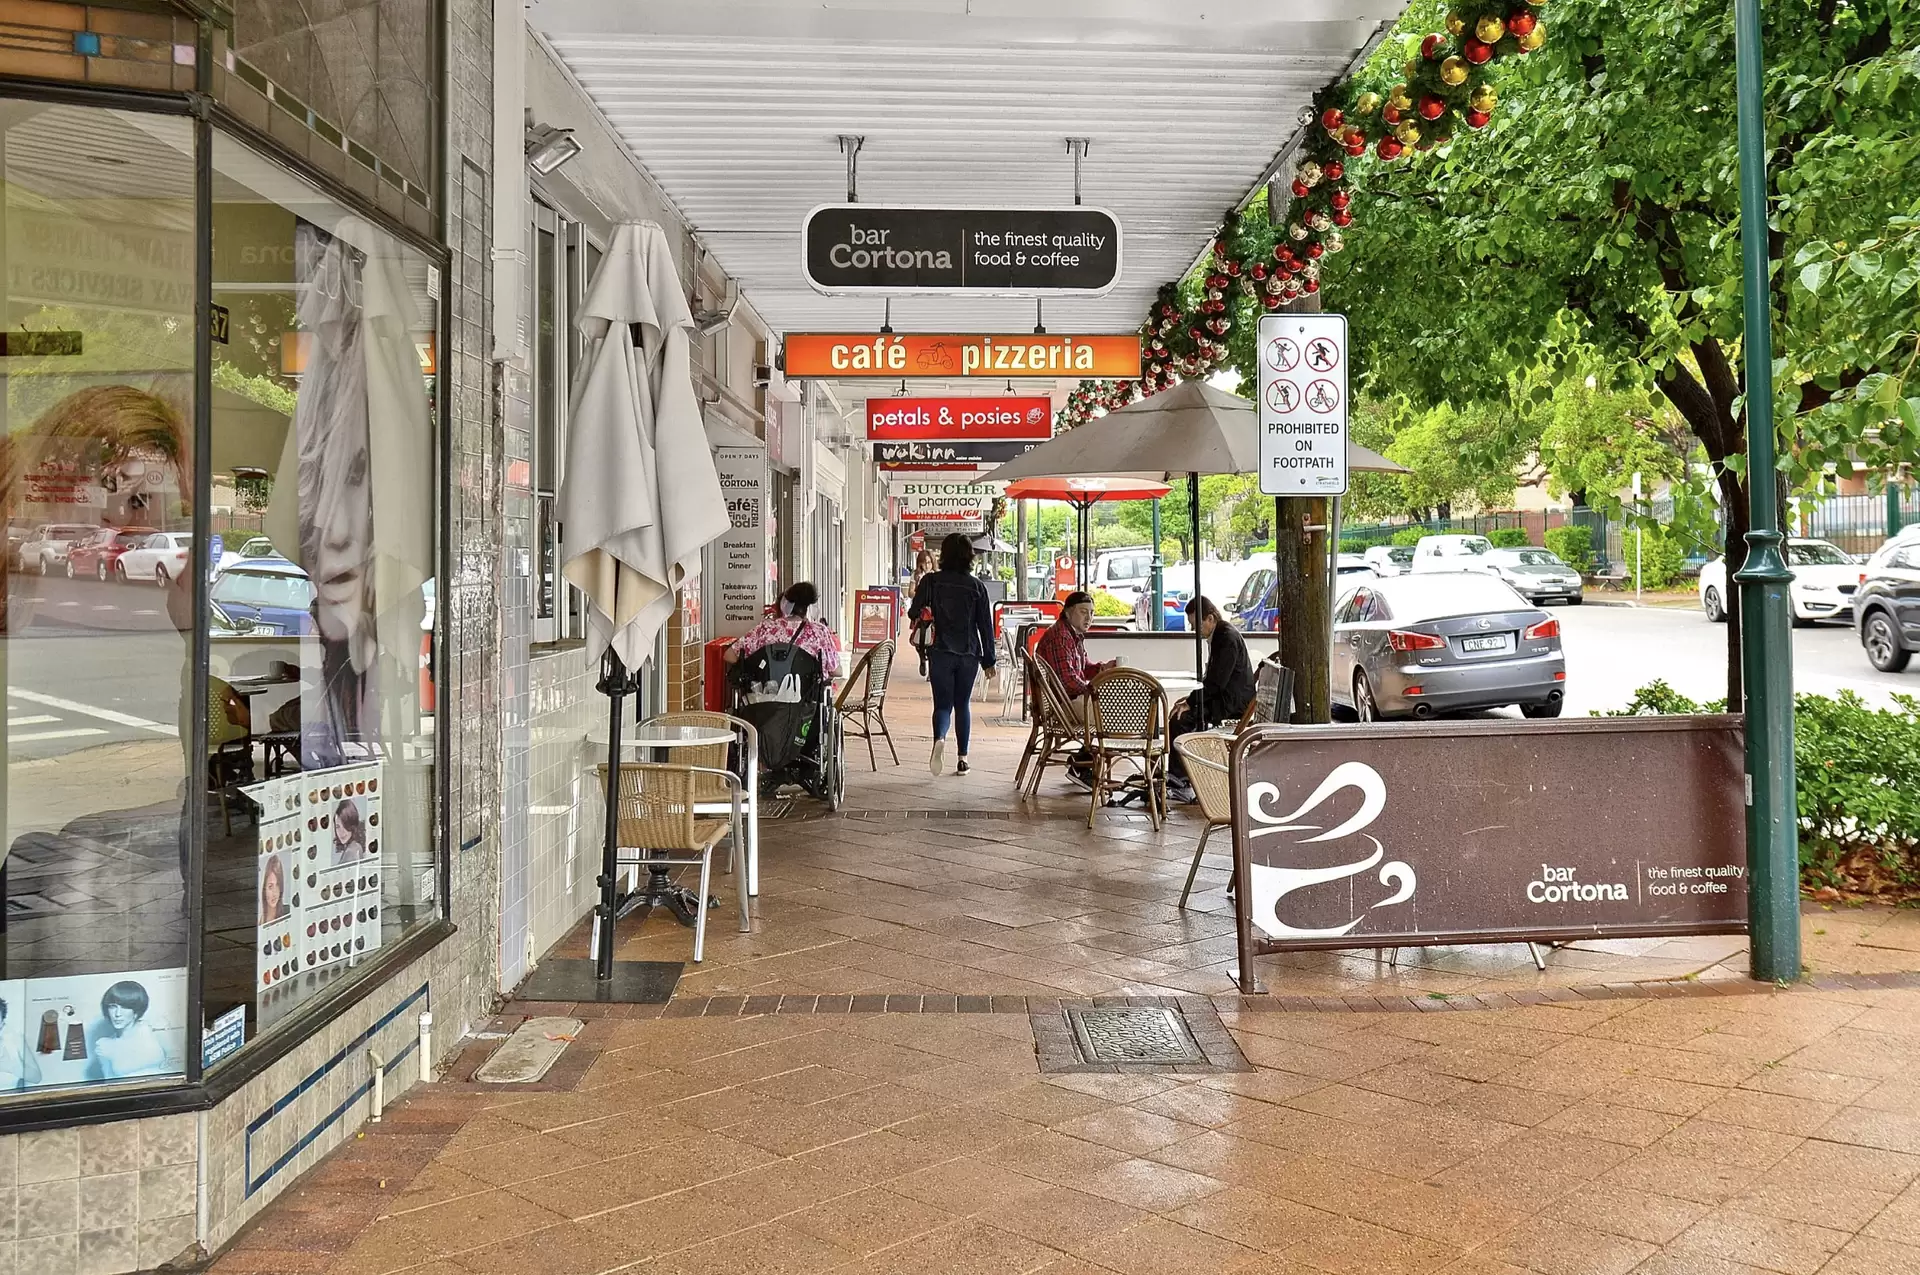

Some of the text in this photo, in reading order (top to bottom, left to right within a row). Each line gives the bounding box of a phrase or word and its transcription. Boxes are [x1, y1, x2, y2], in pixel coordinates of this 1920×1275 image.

[849, 224, 890, 246] bar
[974, 231, 1105, 250] the finest quality
[829, 244, 952, 270] Cortona
[974, 250, 1080, 267] food & coffee
[830, 336, 1095, 376] café pizzeria
[872, 407, 1022, 430] petals & posies
[1268, 423, 1340, 435] PROHIBITED
[1295, 440, 1313, 451] ON
[1273, 457, 1334, 469] FOOTPATH
[720, 472, 734, 480] bar
[903, 484, 997, 495] BUTCHER
[724, 498, 751, 511] afé
[918, 497, 982, 508] pharmacy
[751, 498, 759, 528] PIZZERIA
[723, 541, 756, 549] Breakfast
[723, 593, 756, 601] Functions
[725, 603, 754, 612] Catering
[724, 613, 755, 621] Giftware
[1541, 863, 1577, 883] bar
[1647, 864, 1745, 880] the finest quality
[1526, 881, 1629, 904] Cortona
[1648, 882, 1728, 896] food & coffee
